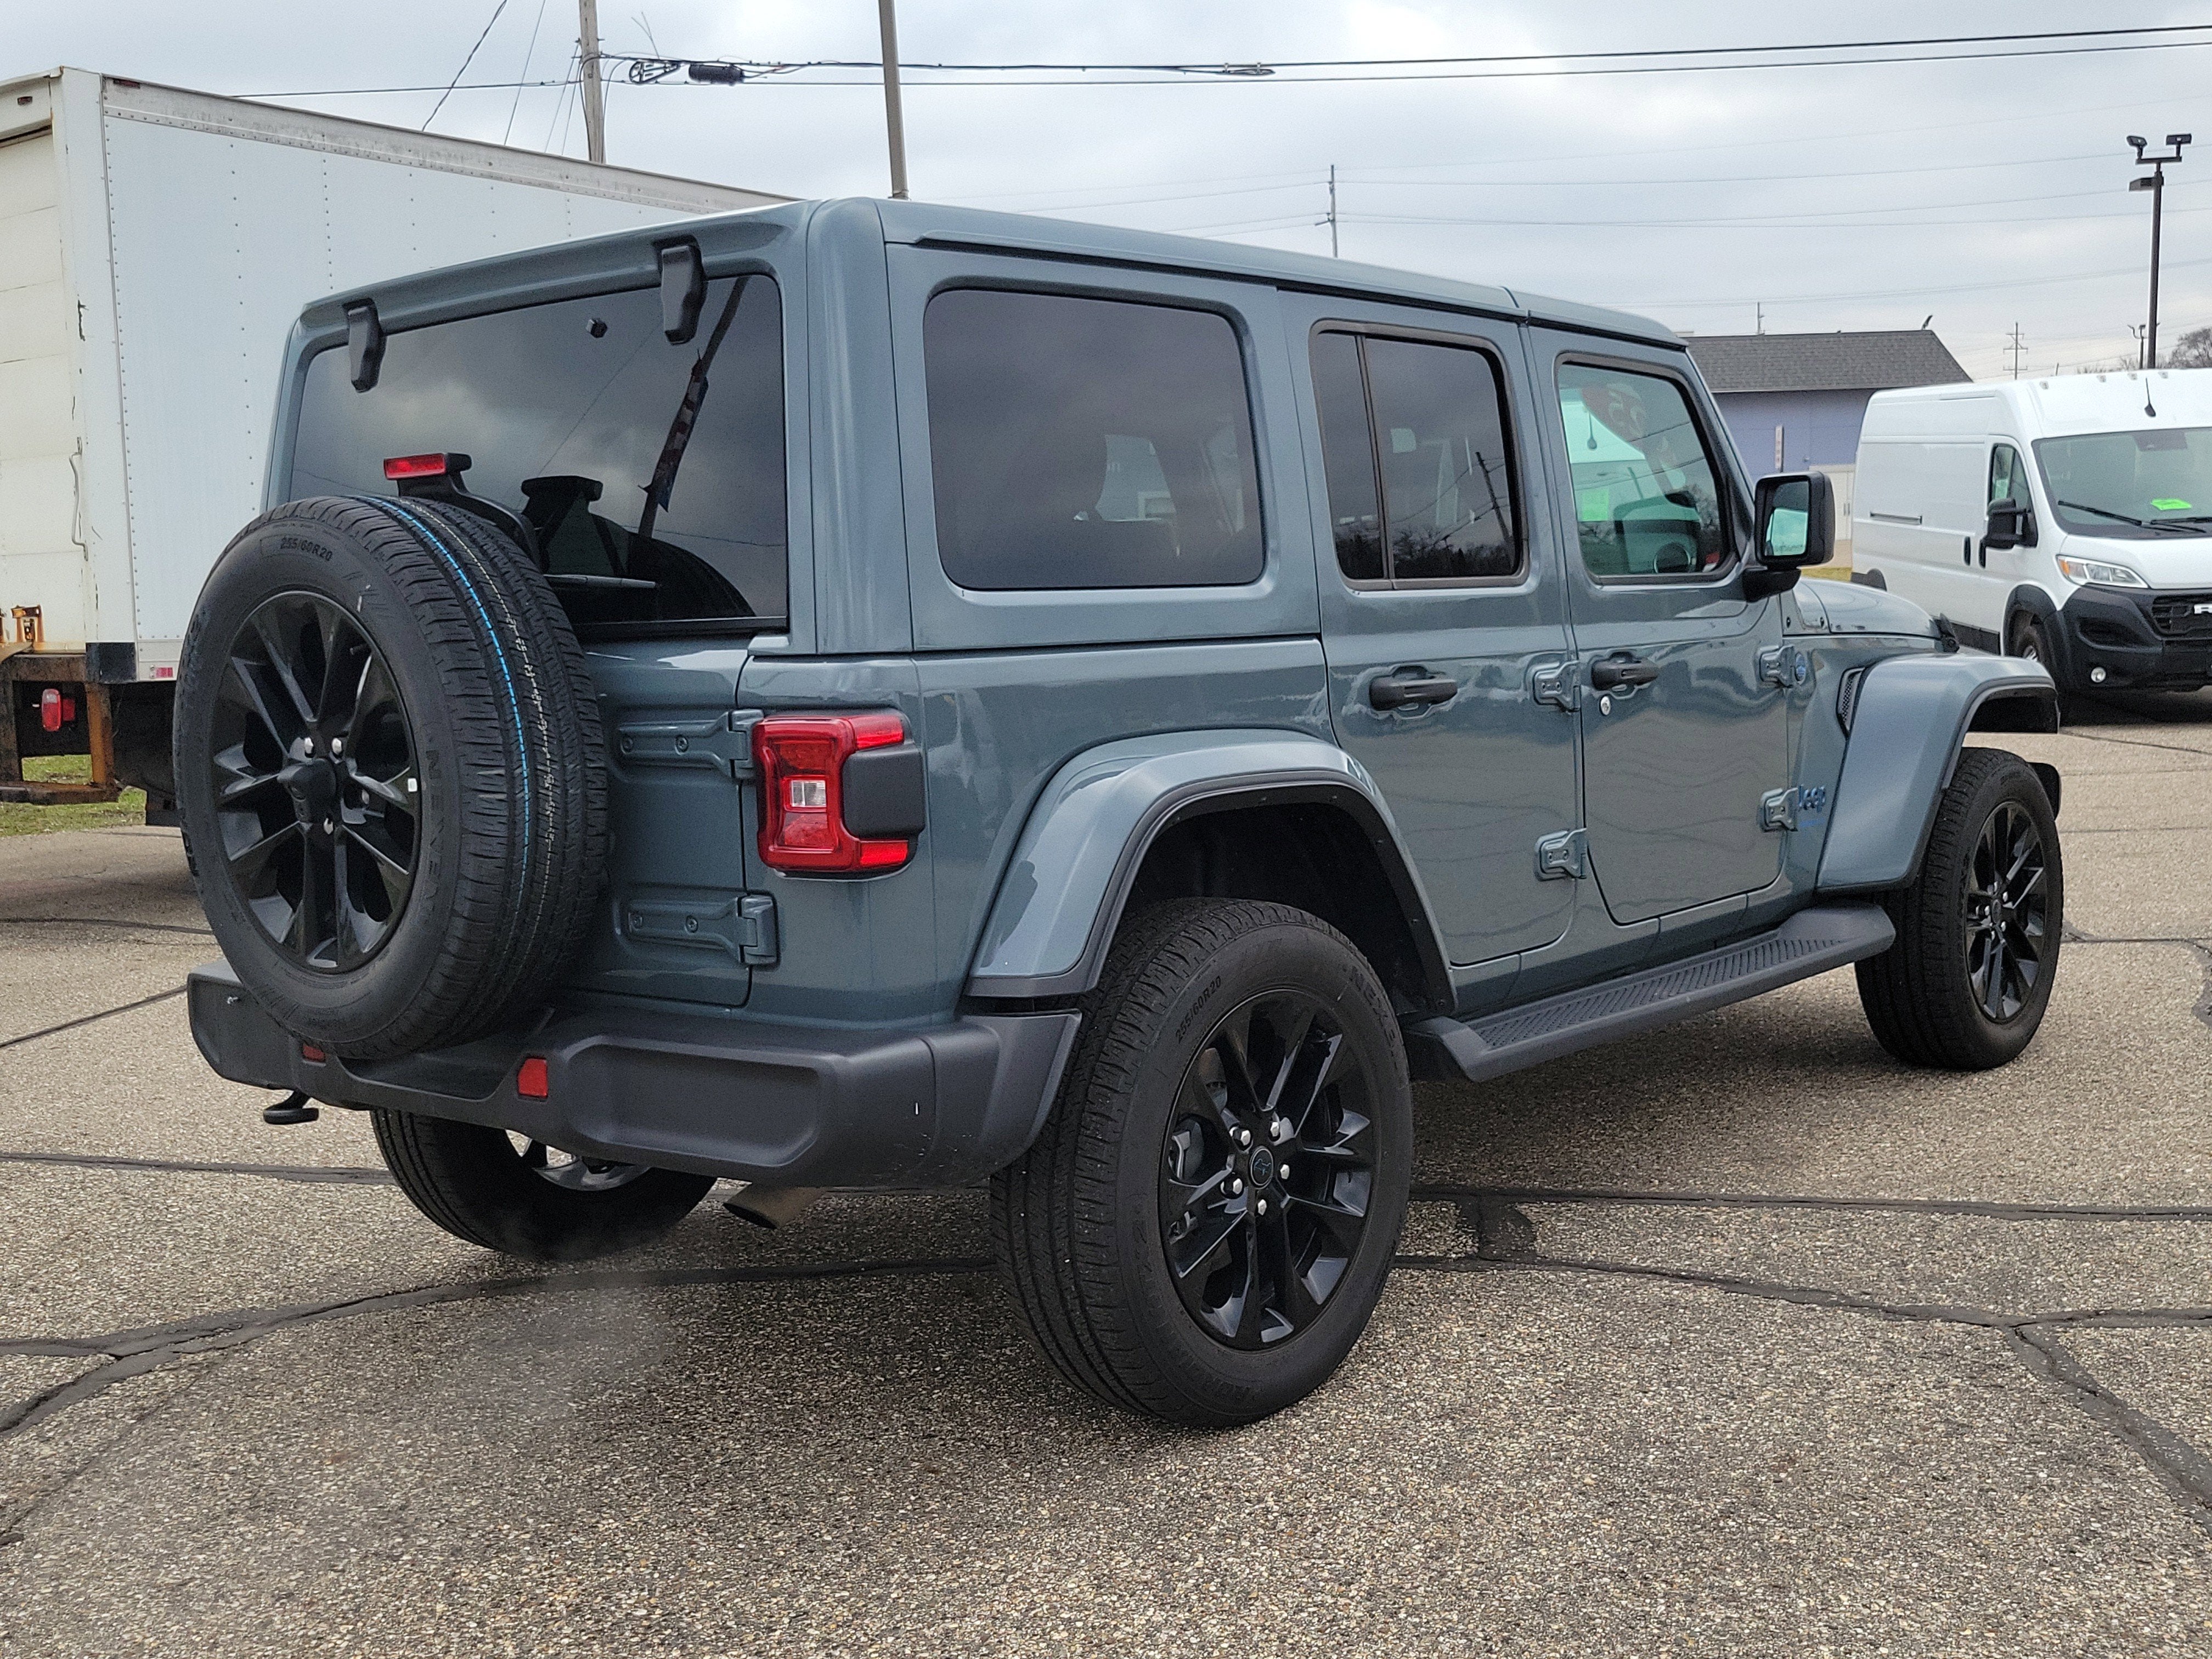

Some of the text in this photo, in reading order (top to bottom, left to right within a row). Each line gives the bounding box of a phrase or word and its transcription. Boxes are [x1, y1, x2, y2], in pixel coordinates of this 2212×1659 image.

[280, 537, 334, 562] 255/60R20
[1799, 783, 1826, 813] Jeep
[1175, 975, 1222, 1044] 255/60R20
